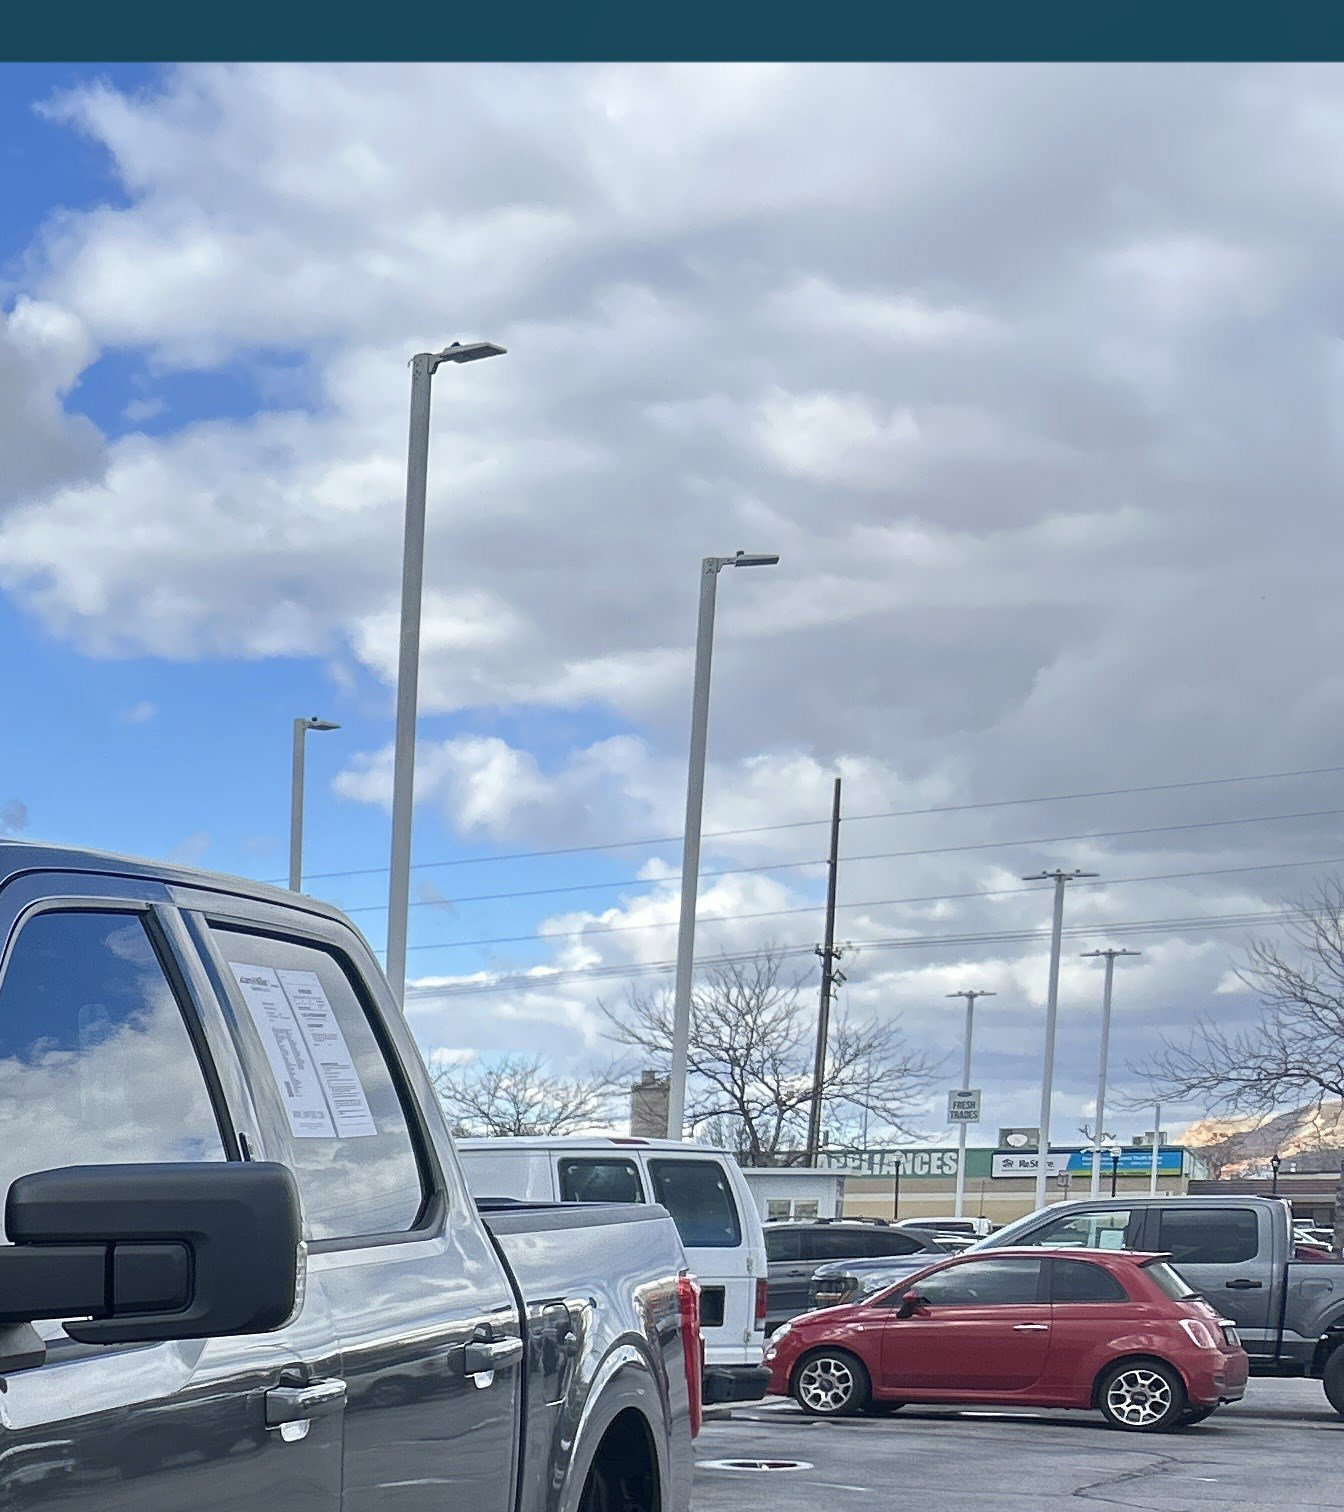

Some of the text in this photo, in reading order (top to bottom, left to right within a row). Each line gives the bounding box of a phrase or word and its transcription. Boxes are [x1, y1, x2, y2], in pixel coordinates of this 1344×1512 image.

[952, 1100, 976, 1110] FRESH
[950, 1110, 978, 1120] TRADES
[816, 1152, 958, 1175] APPLIANCES
